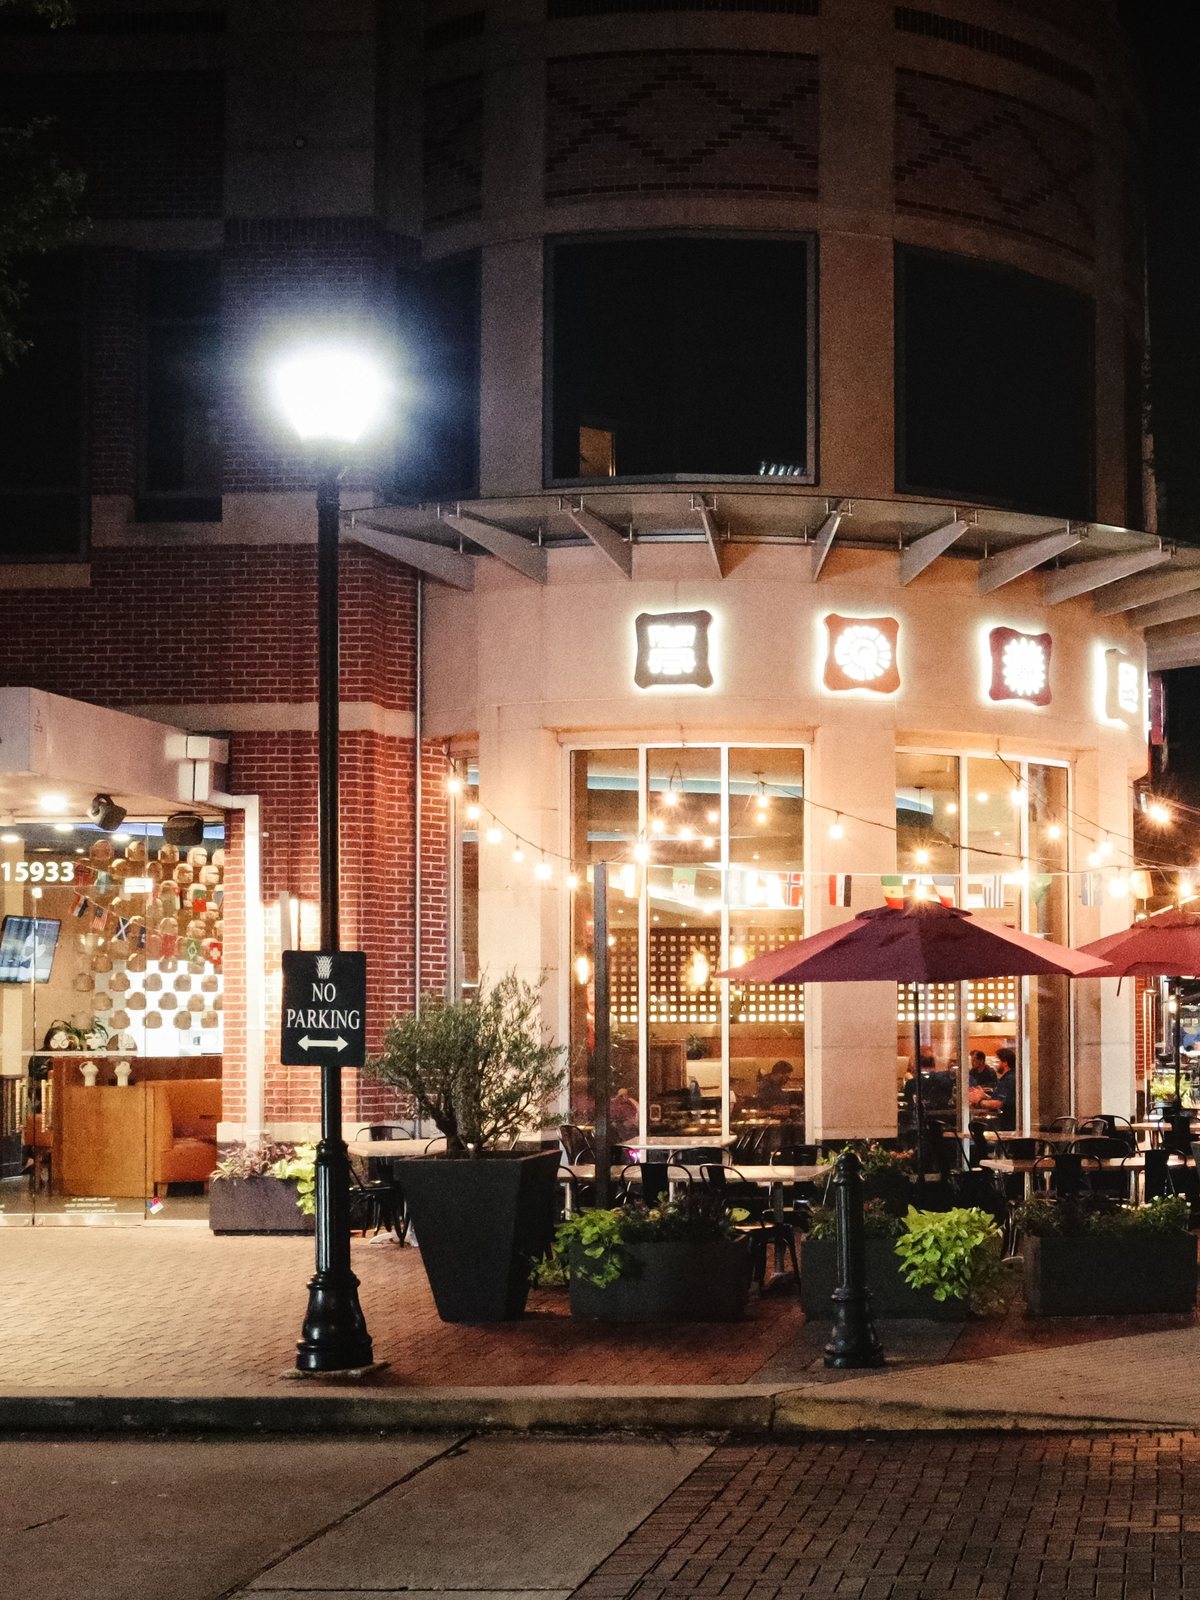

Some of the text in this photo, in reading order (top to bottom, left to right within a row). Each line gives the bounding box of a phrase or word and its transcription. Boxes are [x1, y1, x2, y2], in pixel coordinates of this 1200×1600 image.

[1, 861, 75, 882] 15933
[311, 982, 336, 1003] NO
[286, 1008, 360, 1030] PARKING
